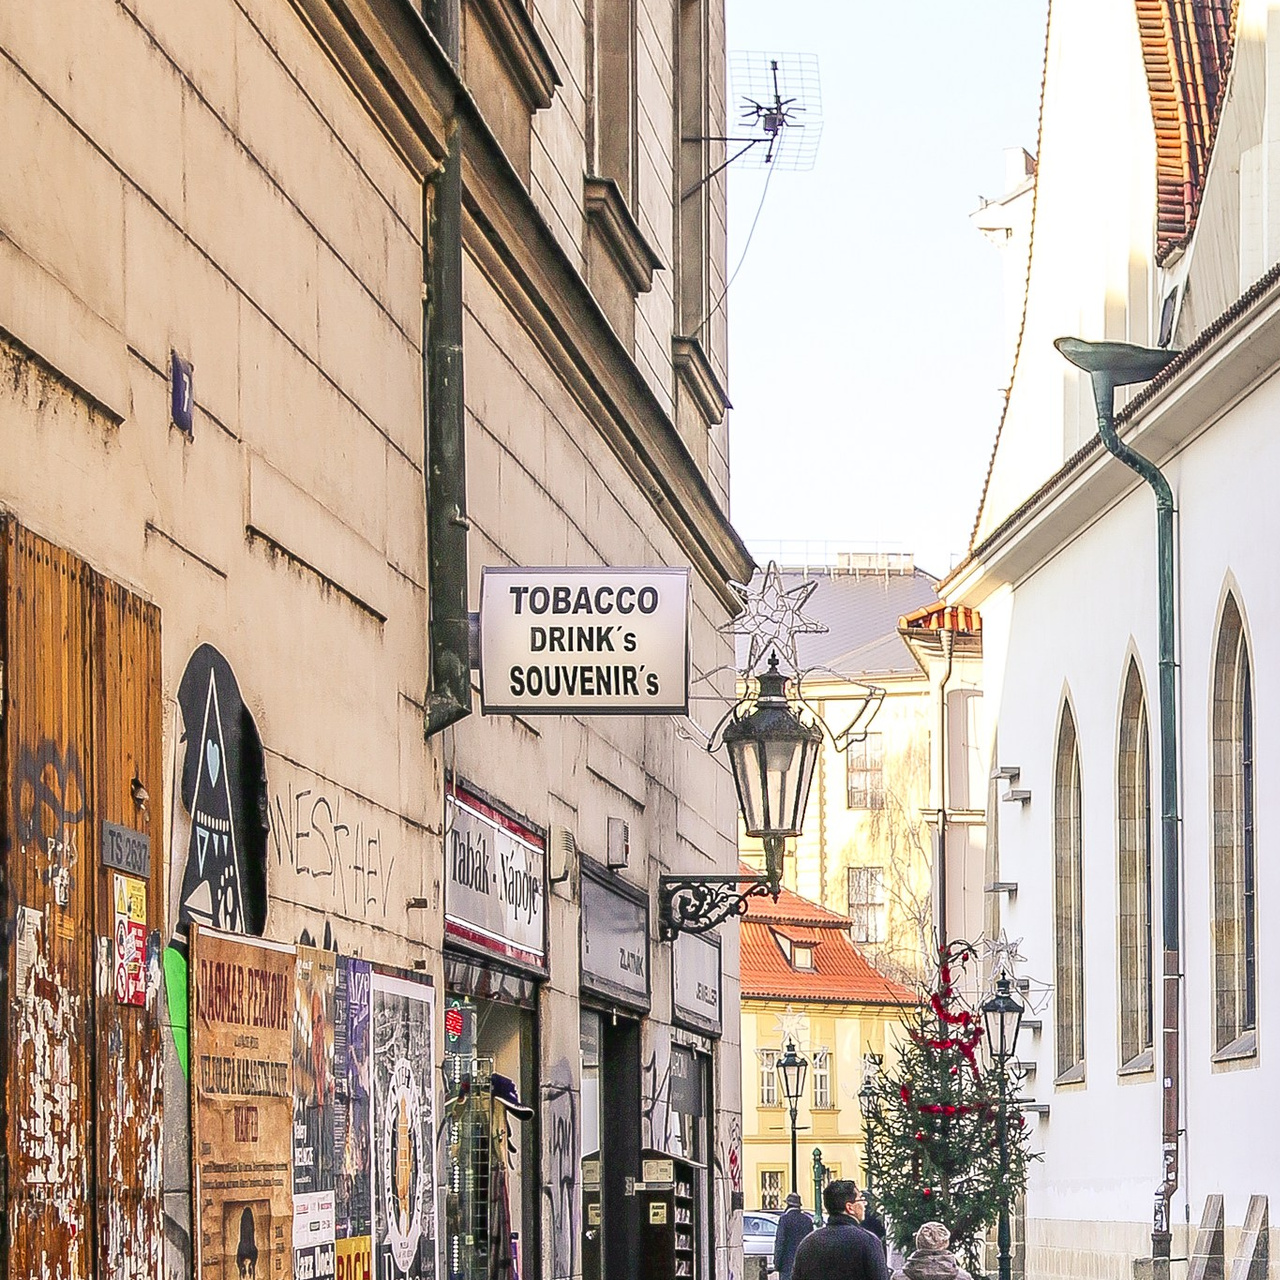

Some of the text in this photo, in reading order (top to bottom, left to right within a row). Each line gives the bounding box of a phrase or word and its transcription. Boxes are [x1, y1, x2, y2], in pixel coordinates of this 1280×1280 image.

[509, 586, 659, 615] TOBACCO
[108, 829, 122, 866] TS
[451, 828, 490, 896] Tabák
[500, 851, 539, 926] Nápoje
[201, 958, 245, 1026] DAGMAR
[314, 1245, 334, 1278] Dock
